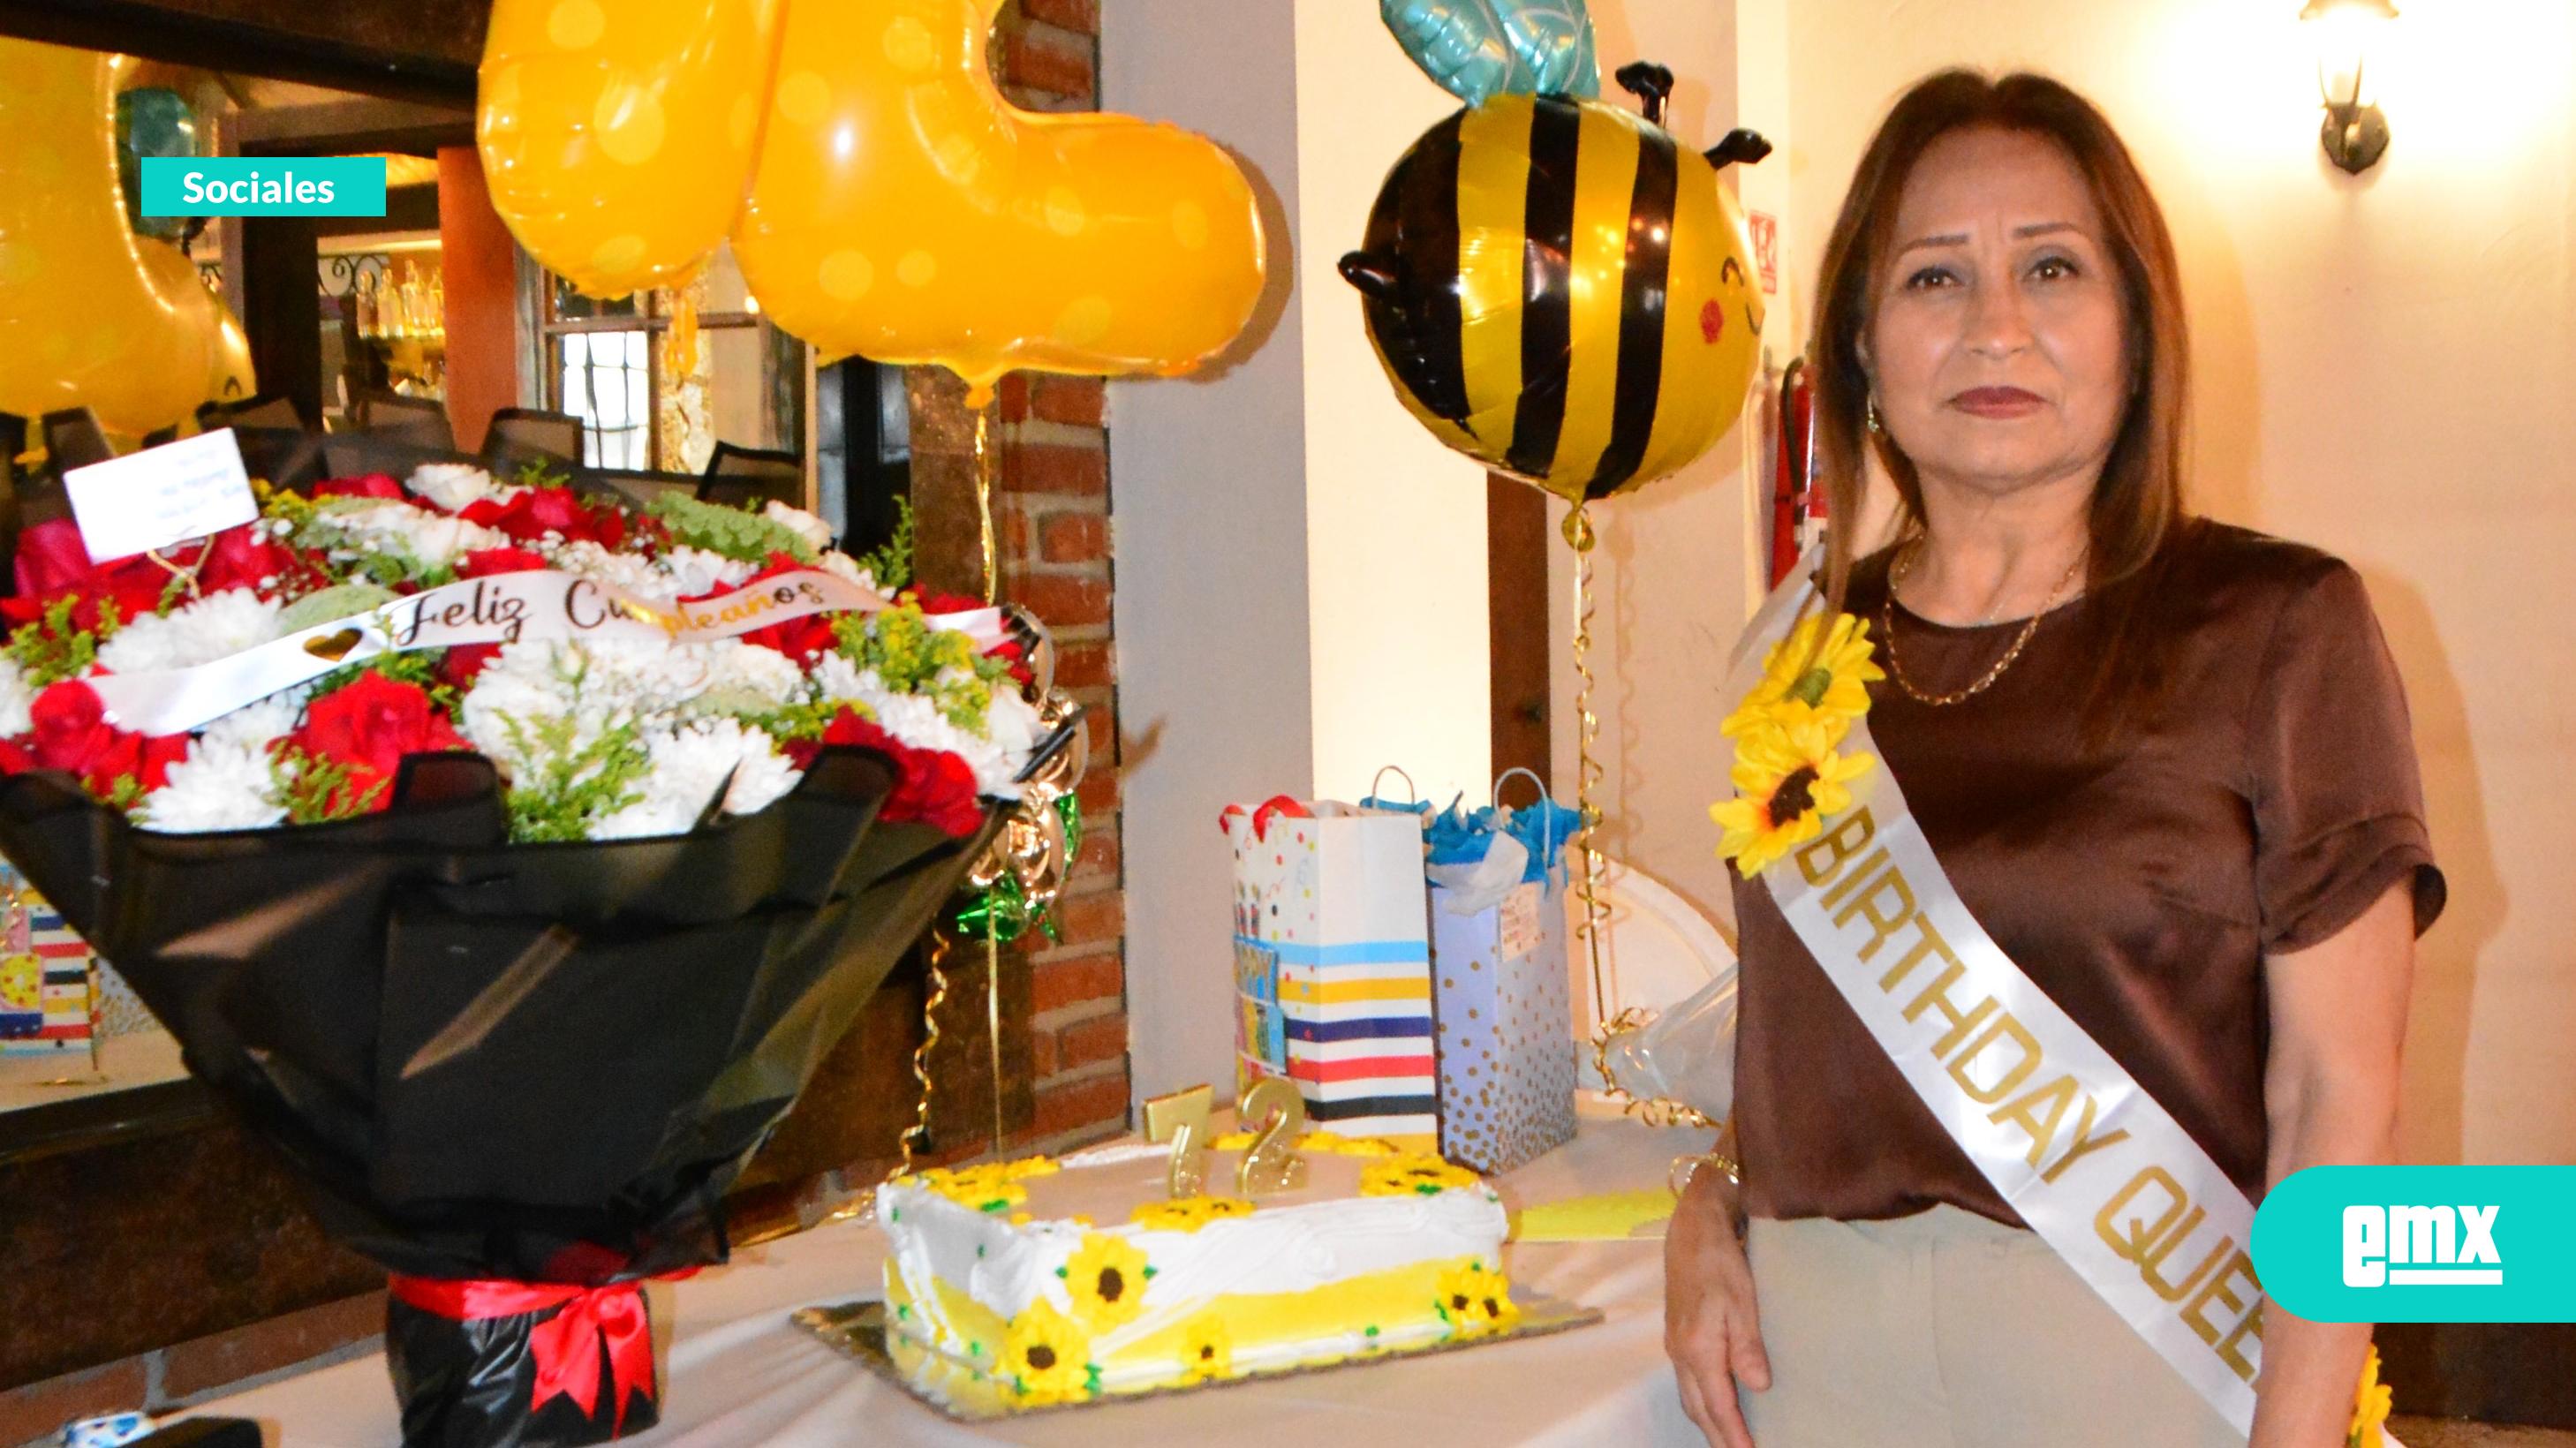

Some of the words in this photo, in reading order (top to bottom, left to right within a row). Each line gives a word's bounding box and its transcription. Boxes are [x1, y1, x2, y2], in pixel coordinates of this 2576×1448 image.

[395, 579, 531, 645] Feliz
[563, 577, 825, 641] Cupleaños
[1794, 804, 2132, 1186] BIRTHDAY
[2094, 1165, 2264, 1384] QUEE
